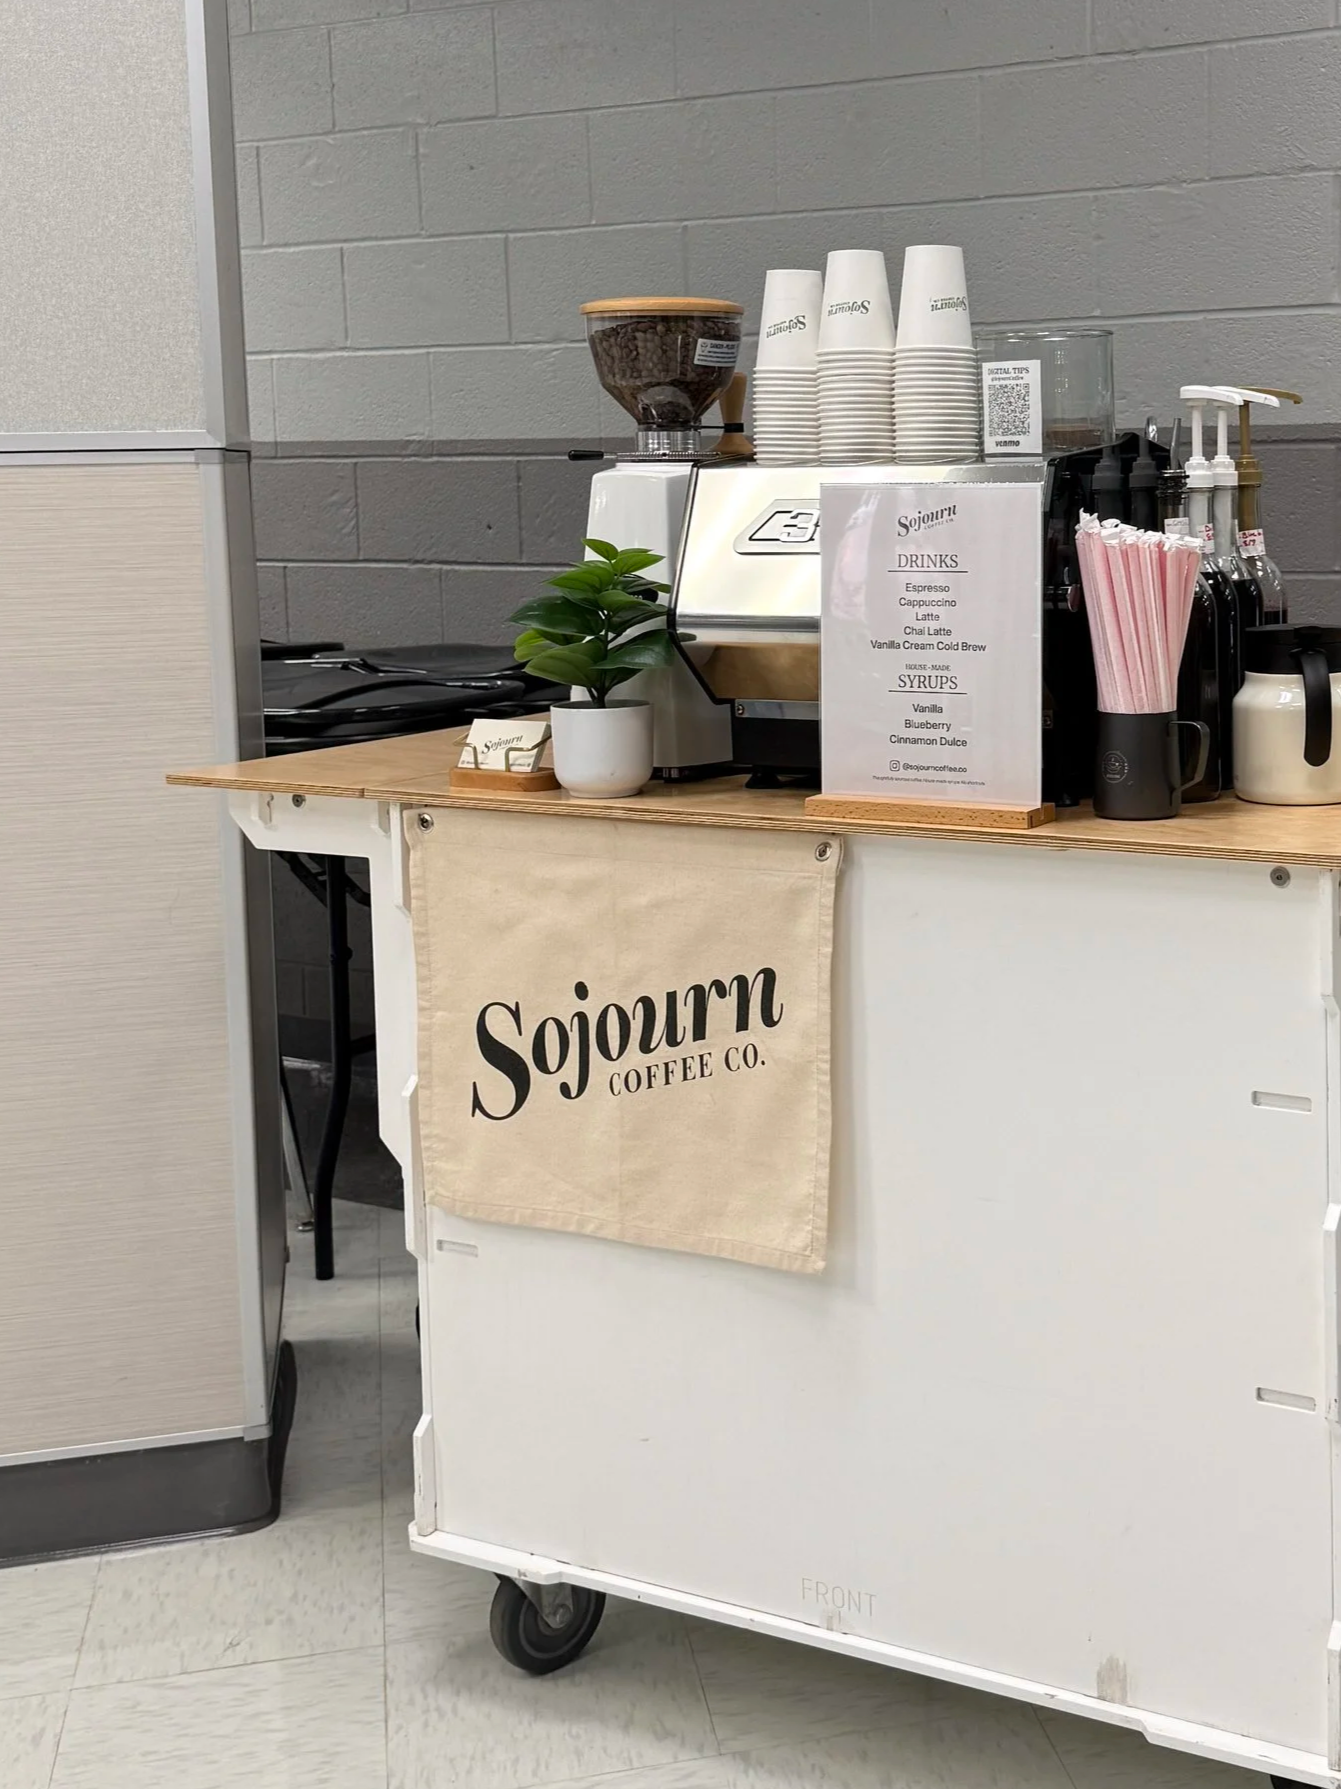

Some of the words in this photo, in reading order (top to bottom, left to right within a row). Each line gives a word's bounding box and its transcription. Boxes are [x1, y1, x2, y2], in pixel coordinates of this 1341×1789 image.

[827, 299, 871, 317] Sojourn
[930, 296, 967, 312] Sojourn
[766, 314, 807, 339] Sojourn
[987, 367, 1011, 375] DIGITAL
[897, 504, 957, 537] Sojourn
[897, 553, 959, 568] DRINKS
[905, 583, 950, 594] Espresso
[898, 597, 957, 609] Cappuccino
[915, 612, 940, 622] Latte
[903, 626, 925, 636] Chai
[927, 627, 952, 636] Latte
[870, 640, 900, 650] Vanilla
[902, 640, 934, 650] Cream
[936, 641, 959, 651] Cold
[961, 642, 986, 652] Brew
[905, 663, 951, 672] HOUSE-MADE
[898, 673, 958, 690] SYRUPS
[912, 703, 943, 714] Vanilla
[904, 719, 951, 732] Blueberry
[481, 735, 524, 754] Sojourn
[889, 734, 937, 746] Cinnamon
[939, 737, 967, 747] Dulce
[902, 762, 968, 773] @sojourncoffee.co
[471, 967, 784, 1121] Sojourn
[609, 1051, 714, 1097] COFFEE
[724, 1042, 766, 1073] CO.
[801, 1577, 878, 1617] FRONT
